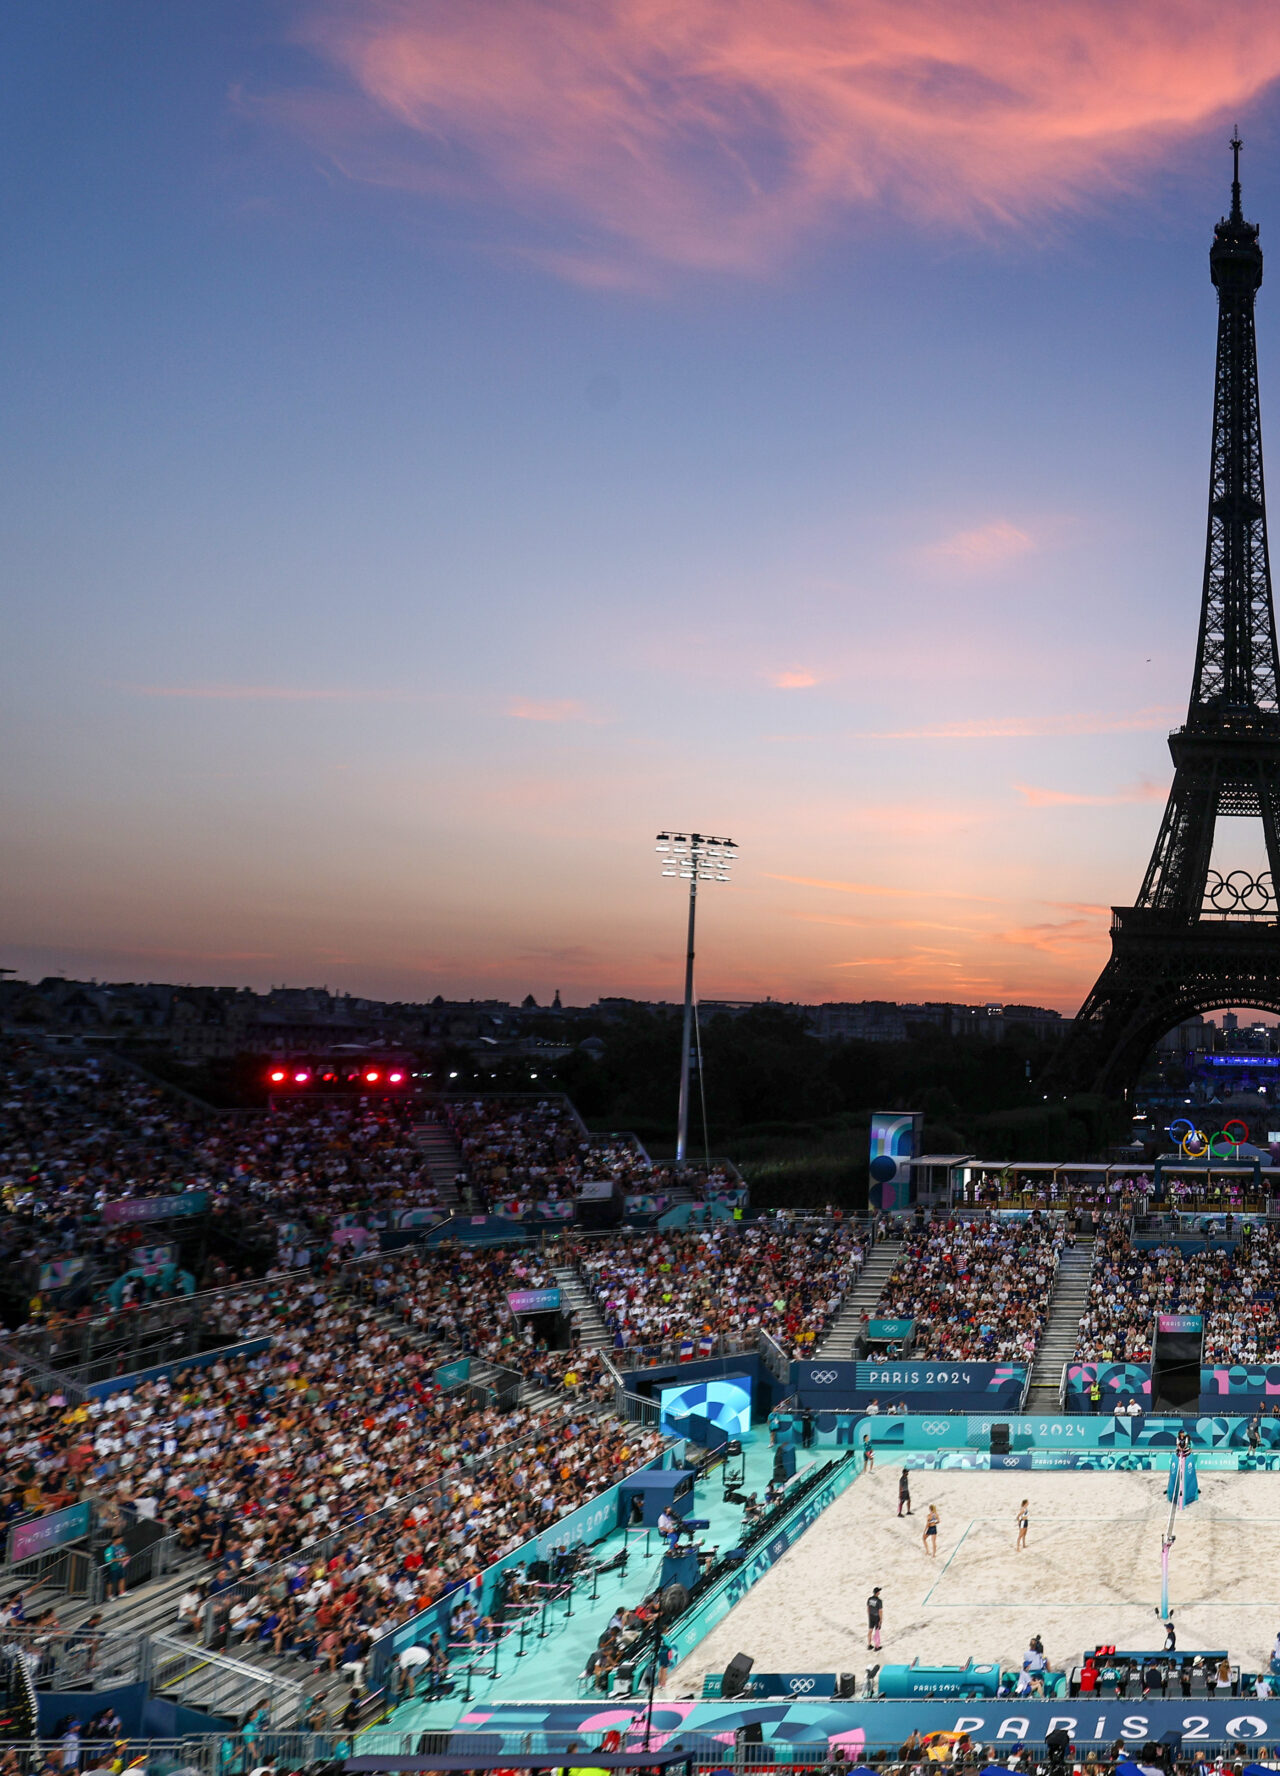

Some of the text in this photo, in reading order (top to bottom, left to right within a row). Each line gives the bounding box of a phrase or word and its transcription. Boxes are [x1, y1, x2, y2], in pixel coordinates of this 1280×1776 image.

[926, 1372, 970, 1384] 2024
[982, 1423, 1085, 1436] PRIS 2024
